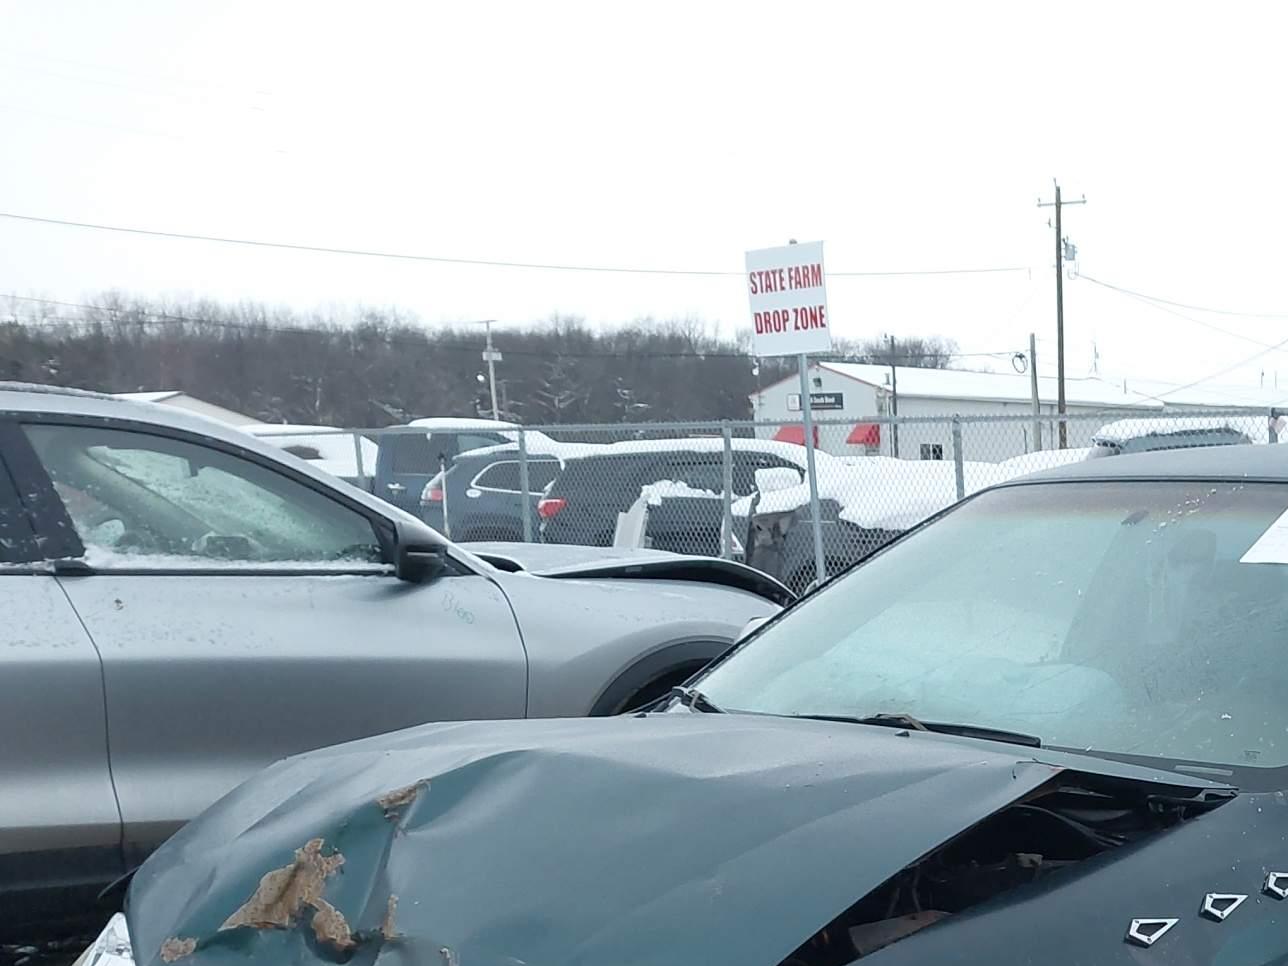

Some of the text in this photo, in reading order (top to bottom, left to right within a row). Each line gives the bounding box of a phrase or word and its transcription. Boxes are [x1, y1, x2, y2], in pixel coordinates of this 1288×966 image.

[749, 264, 822, 294] STATE FARM
[754, 305, 826, 334] DROP ZONE
